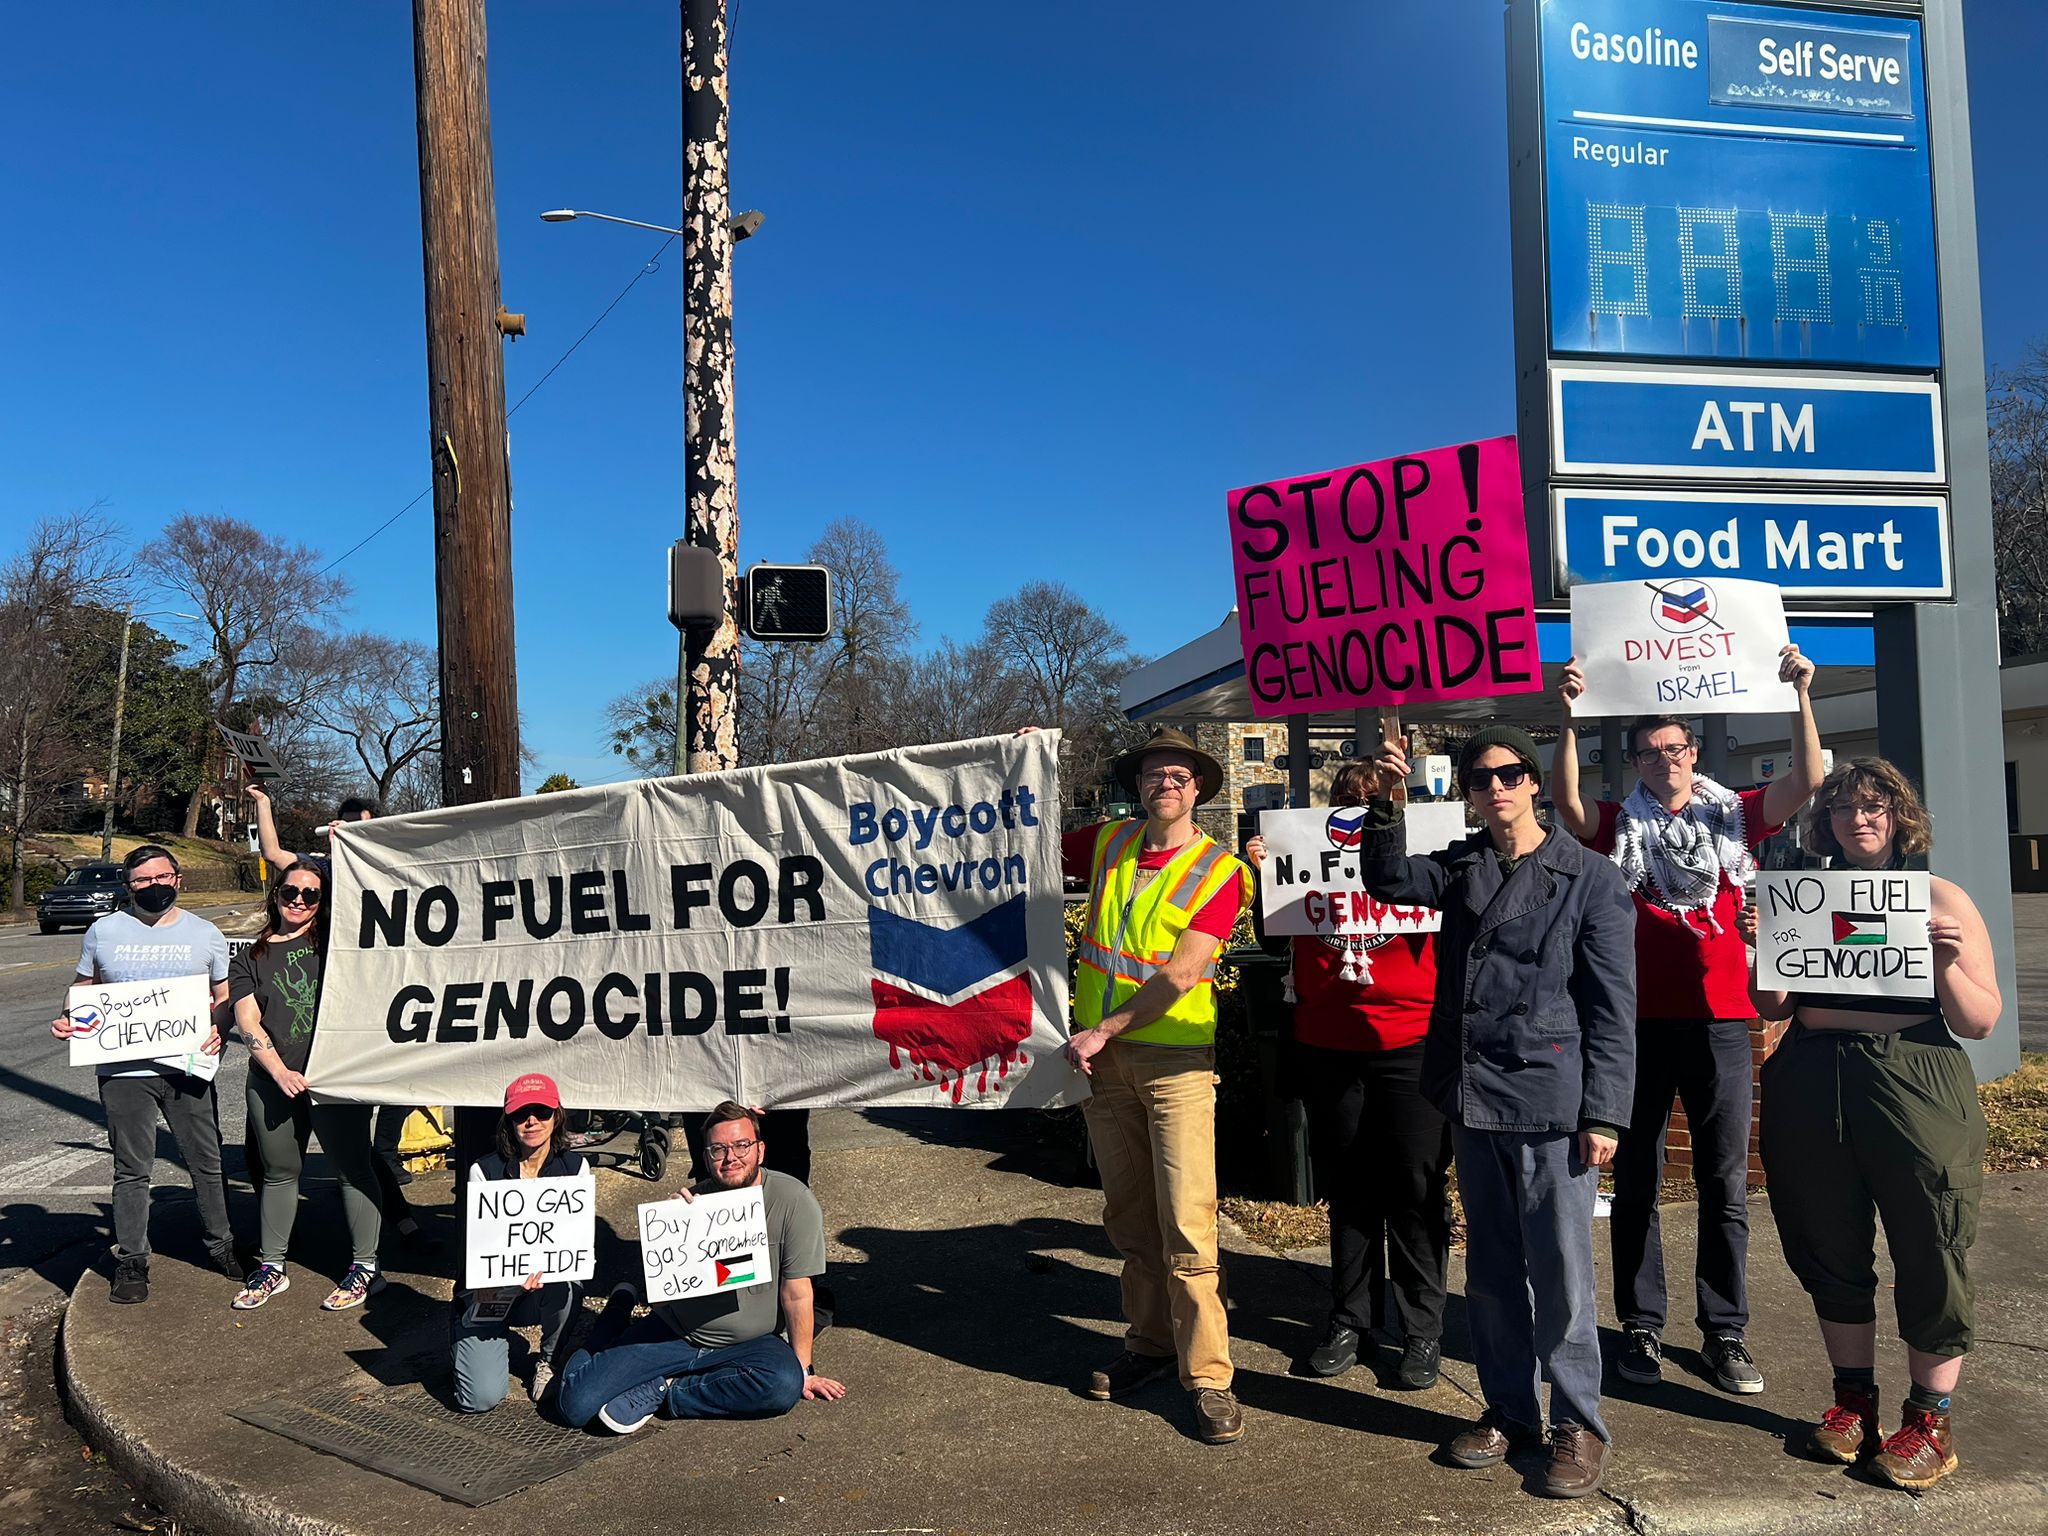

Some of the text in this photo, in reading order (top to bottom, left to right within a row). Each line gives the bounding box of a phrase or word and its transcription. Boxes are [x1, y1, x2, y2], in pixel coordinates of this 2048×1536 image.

[1570, 22, 1901, 85] Gasoline Self Serve
[1573, 137, 1669, 168] Regular
[1691, 400, 1815, 454] ATM
[1602, 515, 1904, 572] Food Mart
[1244, 535, 1485, 630] FUELING
[1250, 607, 1531, 704] GENOCIDE
[1624, 631, 1736, 661] DIVEST
[1679, 663, 1701, 672] from
[1656, 671, 1748, 702] ISRAEL
[232, 735, 264, 758] OUT
[1431, 765, 1446, 773] Self
[849, 785, 1039, 850] Boycott
[865, 850, 1026, 898] Chevron
[358, 854, 826, 949] NO FUEL FOR
[1768, 877, 1926, 916] NO FUEL
[114, 944, 192, 953] PALESTINE
[1772, 928, 1802, 946] FOR
[113, 953, 192, 962] PALESTINE
[1775, 946, 1928, 980] GENOCIDE
[99, 987, 171, 1018] Boycott
[385, 966, 792, 1043] GENOCIDE!
[98, 1015, 197, 1051] CHEVRON
[478, 1188, 587, 1219] NO GAS
[507, 1221, 555, 1248] FOR
[645, 1200, 762, 1242] Buy your
[480, 1249, 589, 1279] THE IDF
[645, 1243, 689, 1279] gas
[663, 1275, 704, 1297] else
